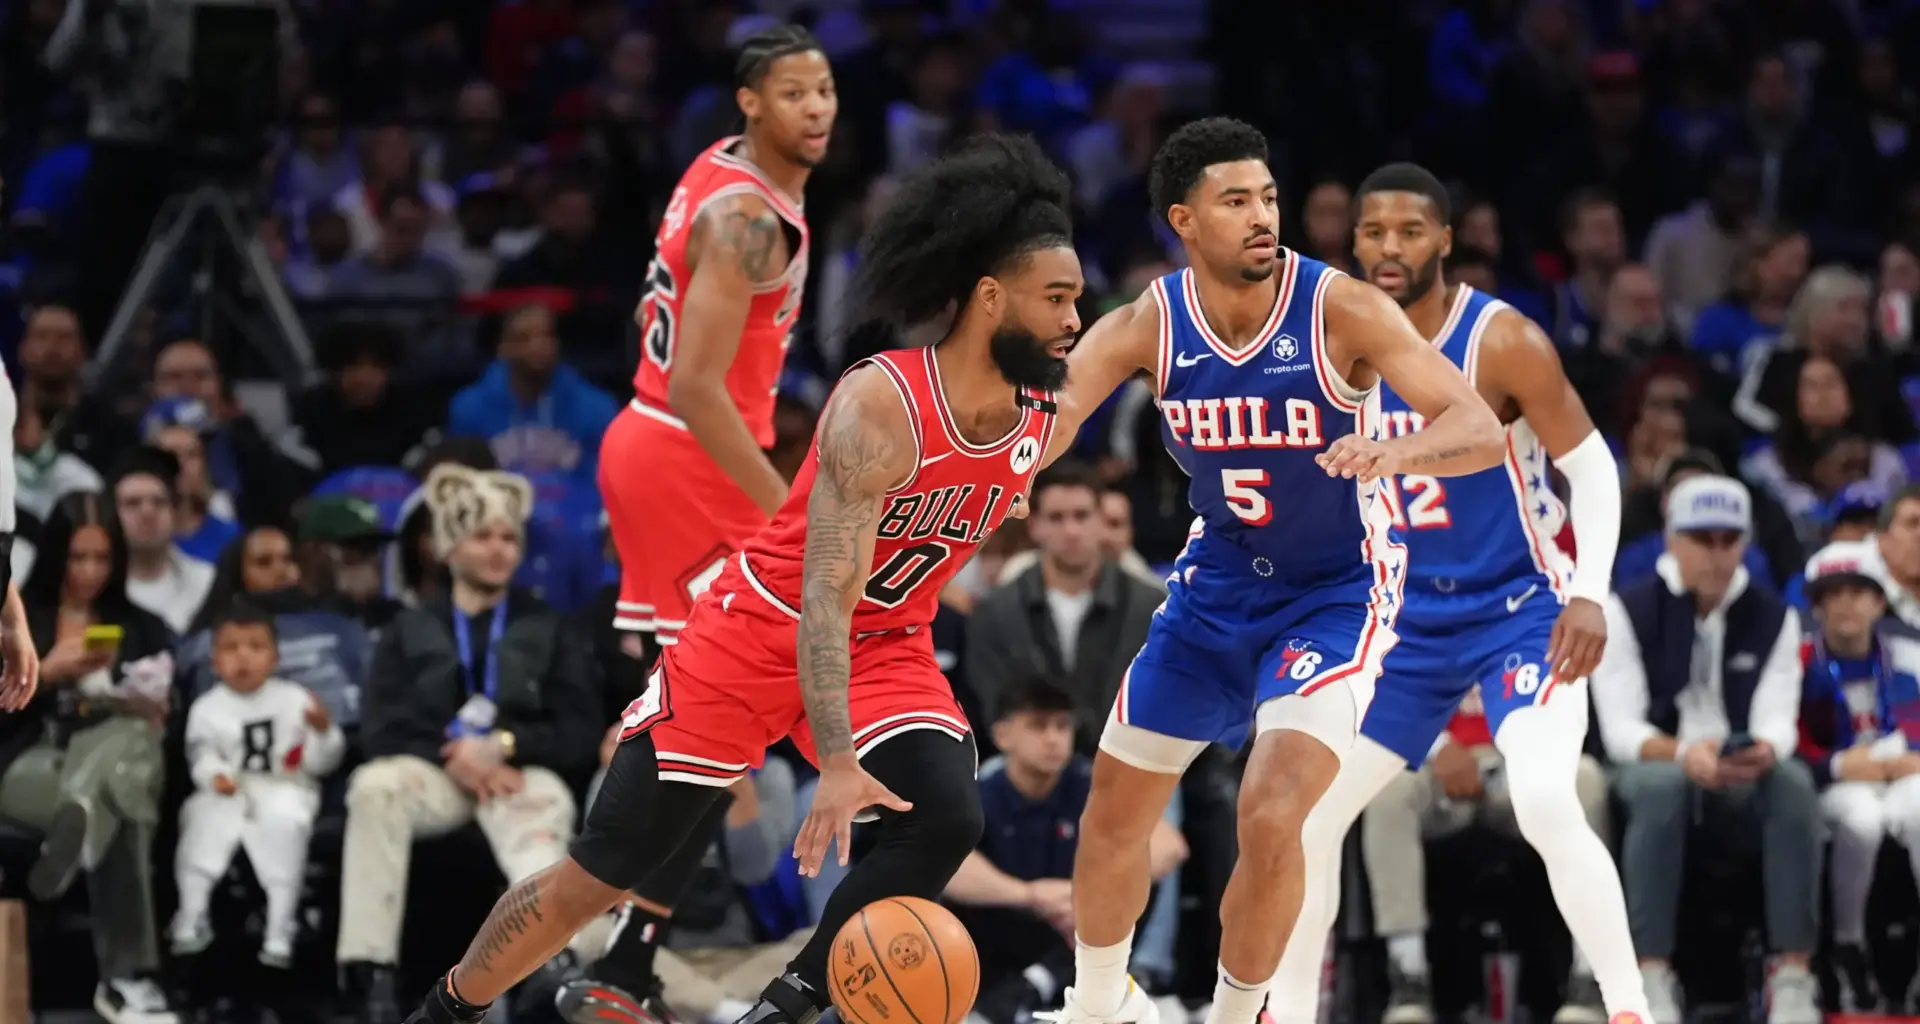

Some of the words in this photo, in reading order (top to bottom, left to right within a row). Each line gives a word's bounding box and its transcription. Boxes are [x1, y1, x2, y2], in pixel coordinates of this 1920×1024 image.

[1263, 362, 1311, 376] crypto.com
[1033, 400, 1041, 410] 10
[1160, 396, 1325, 451] PHILA
[1221, 468, 1273, 527] 5
[861, 541, 950, 609] 0
[1274, 645, 1323, 680] 76
[1501, 662, 1541, 700] 76
